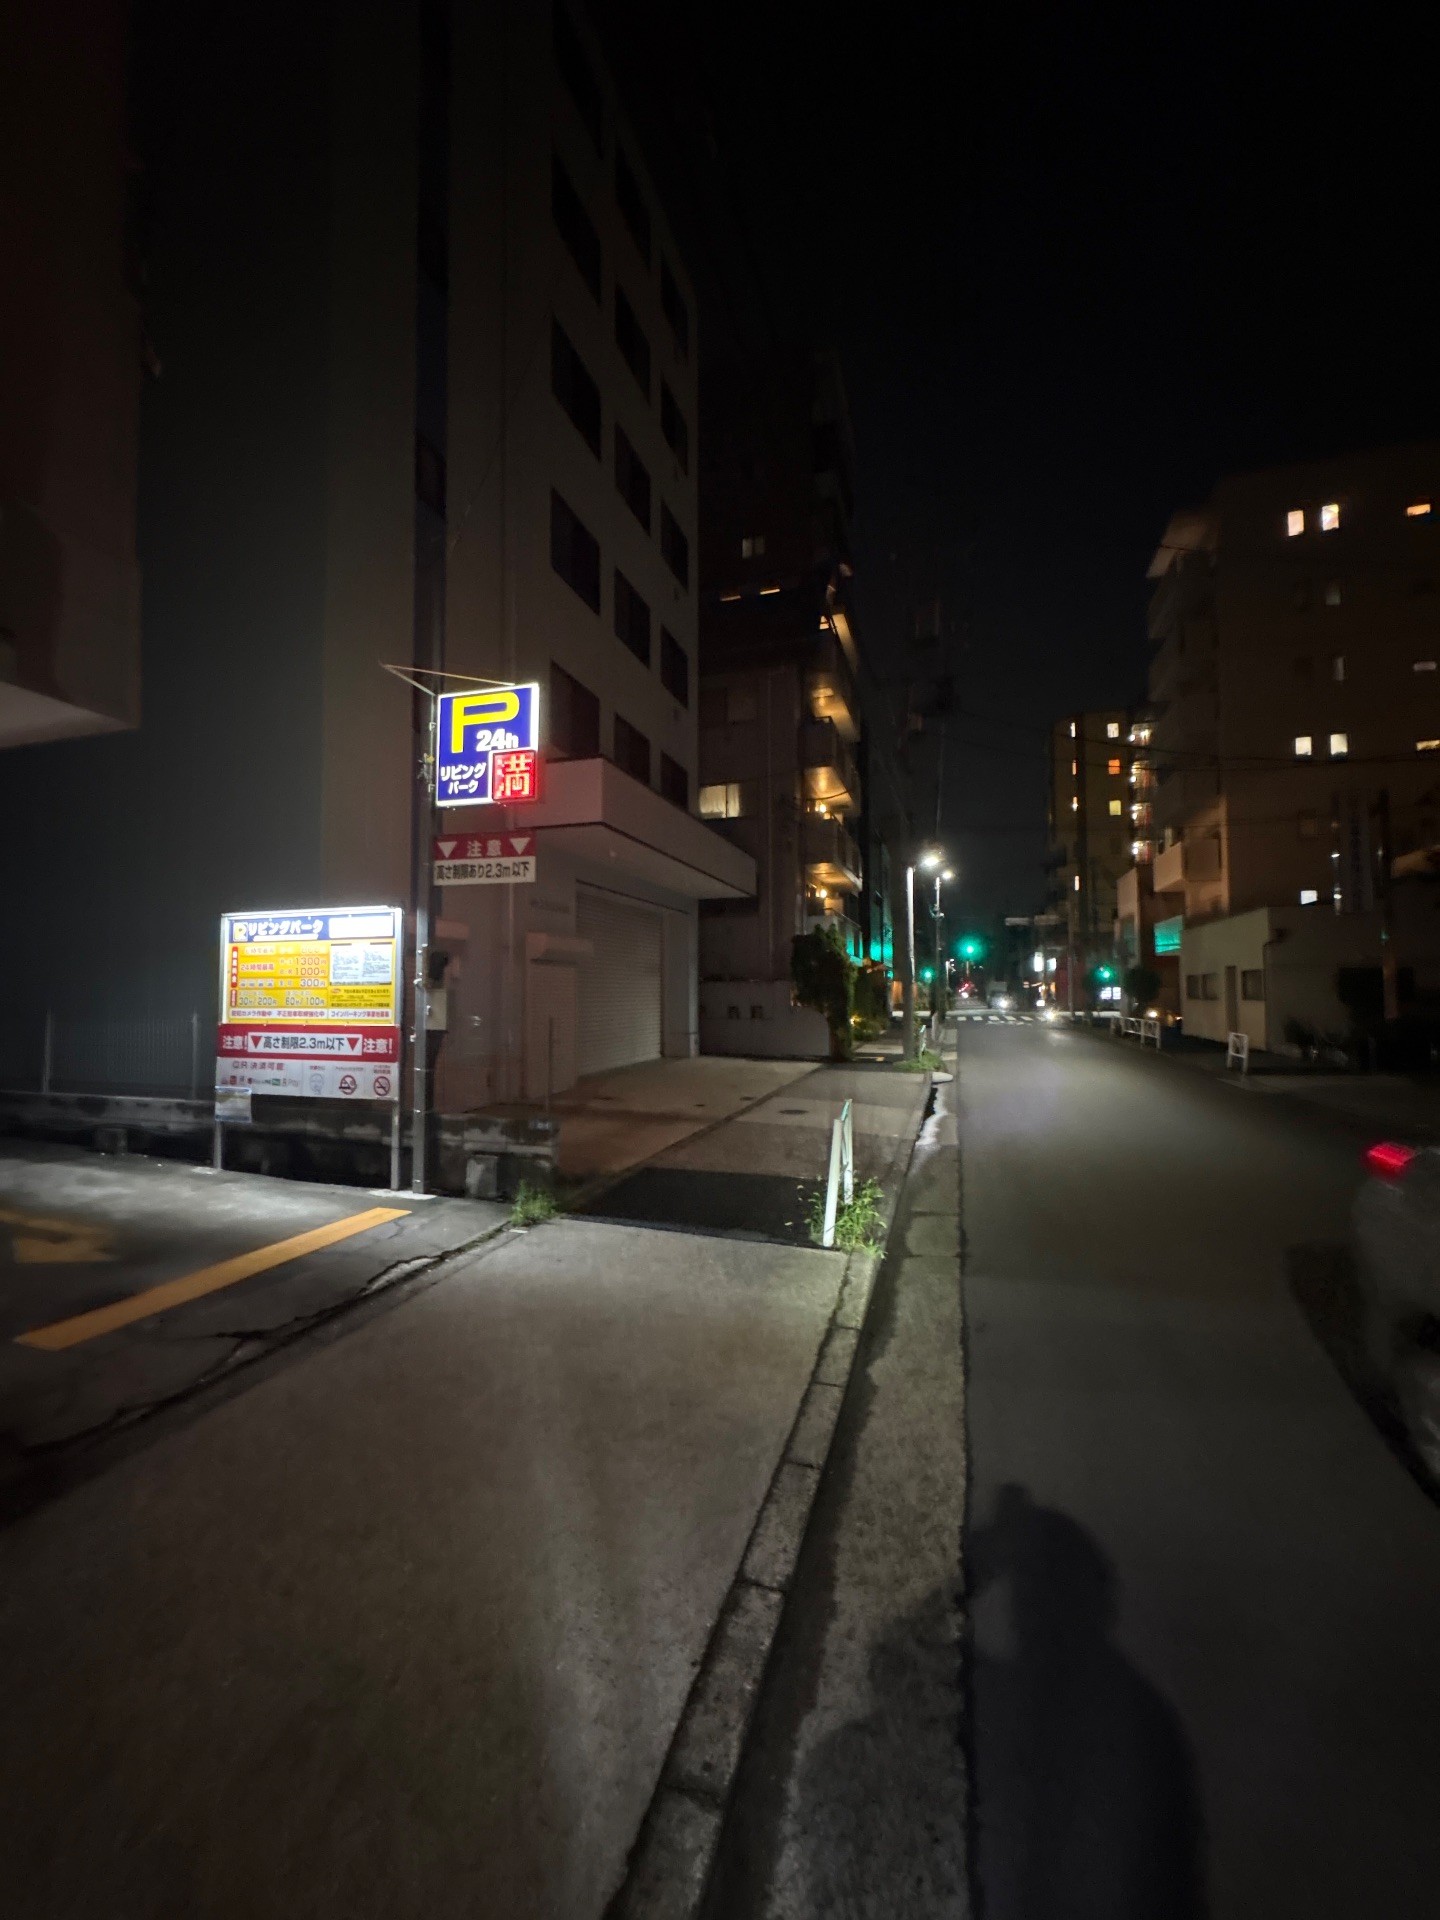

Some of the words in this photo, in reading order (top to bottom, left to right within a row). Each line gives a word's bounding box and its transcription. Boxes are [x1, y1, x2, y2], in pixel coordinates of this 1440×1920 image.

[451, 691, 520, 754] P
[476, 728, 519, 752] 24h
[440, 762, 487, 782] リビング
[495, 753, 533, 798] 満
[447, 779, 479, 795] パーク
[467, 839, 502, 858] 注意
[436, 860, 530, 880] 高さ制限あり2.3m以下
[248, 919, 324, 937] リビングパーク
[263, 1036, 345, 1051] 高さ制限2.3m以下
